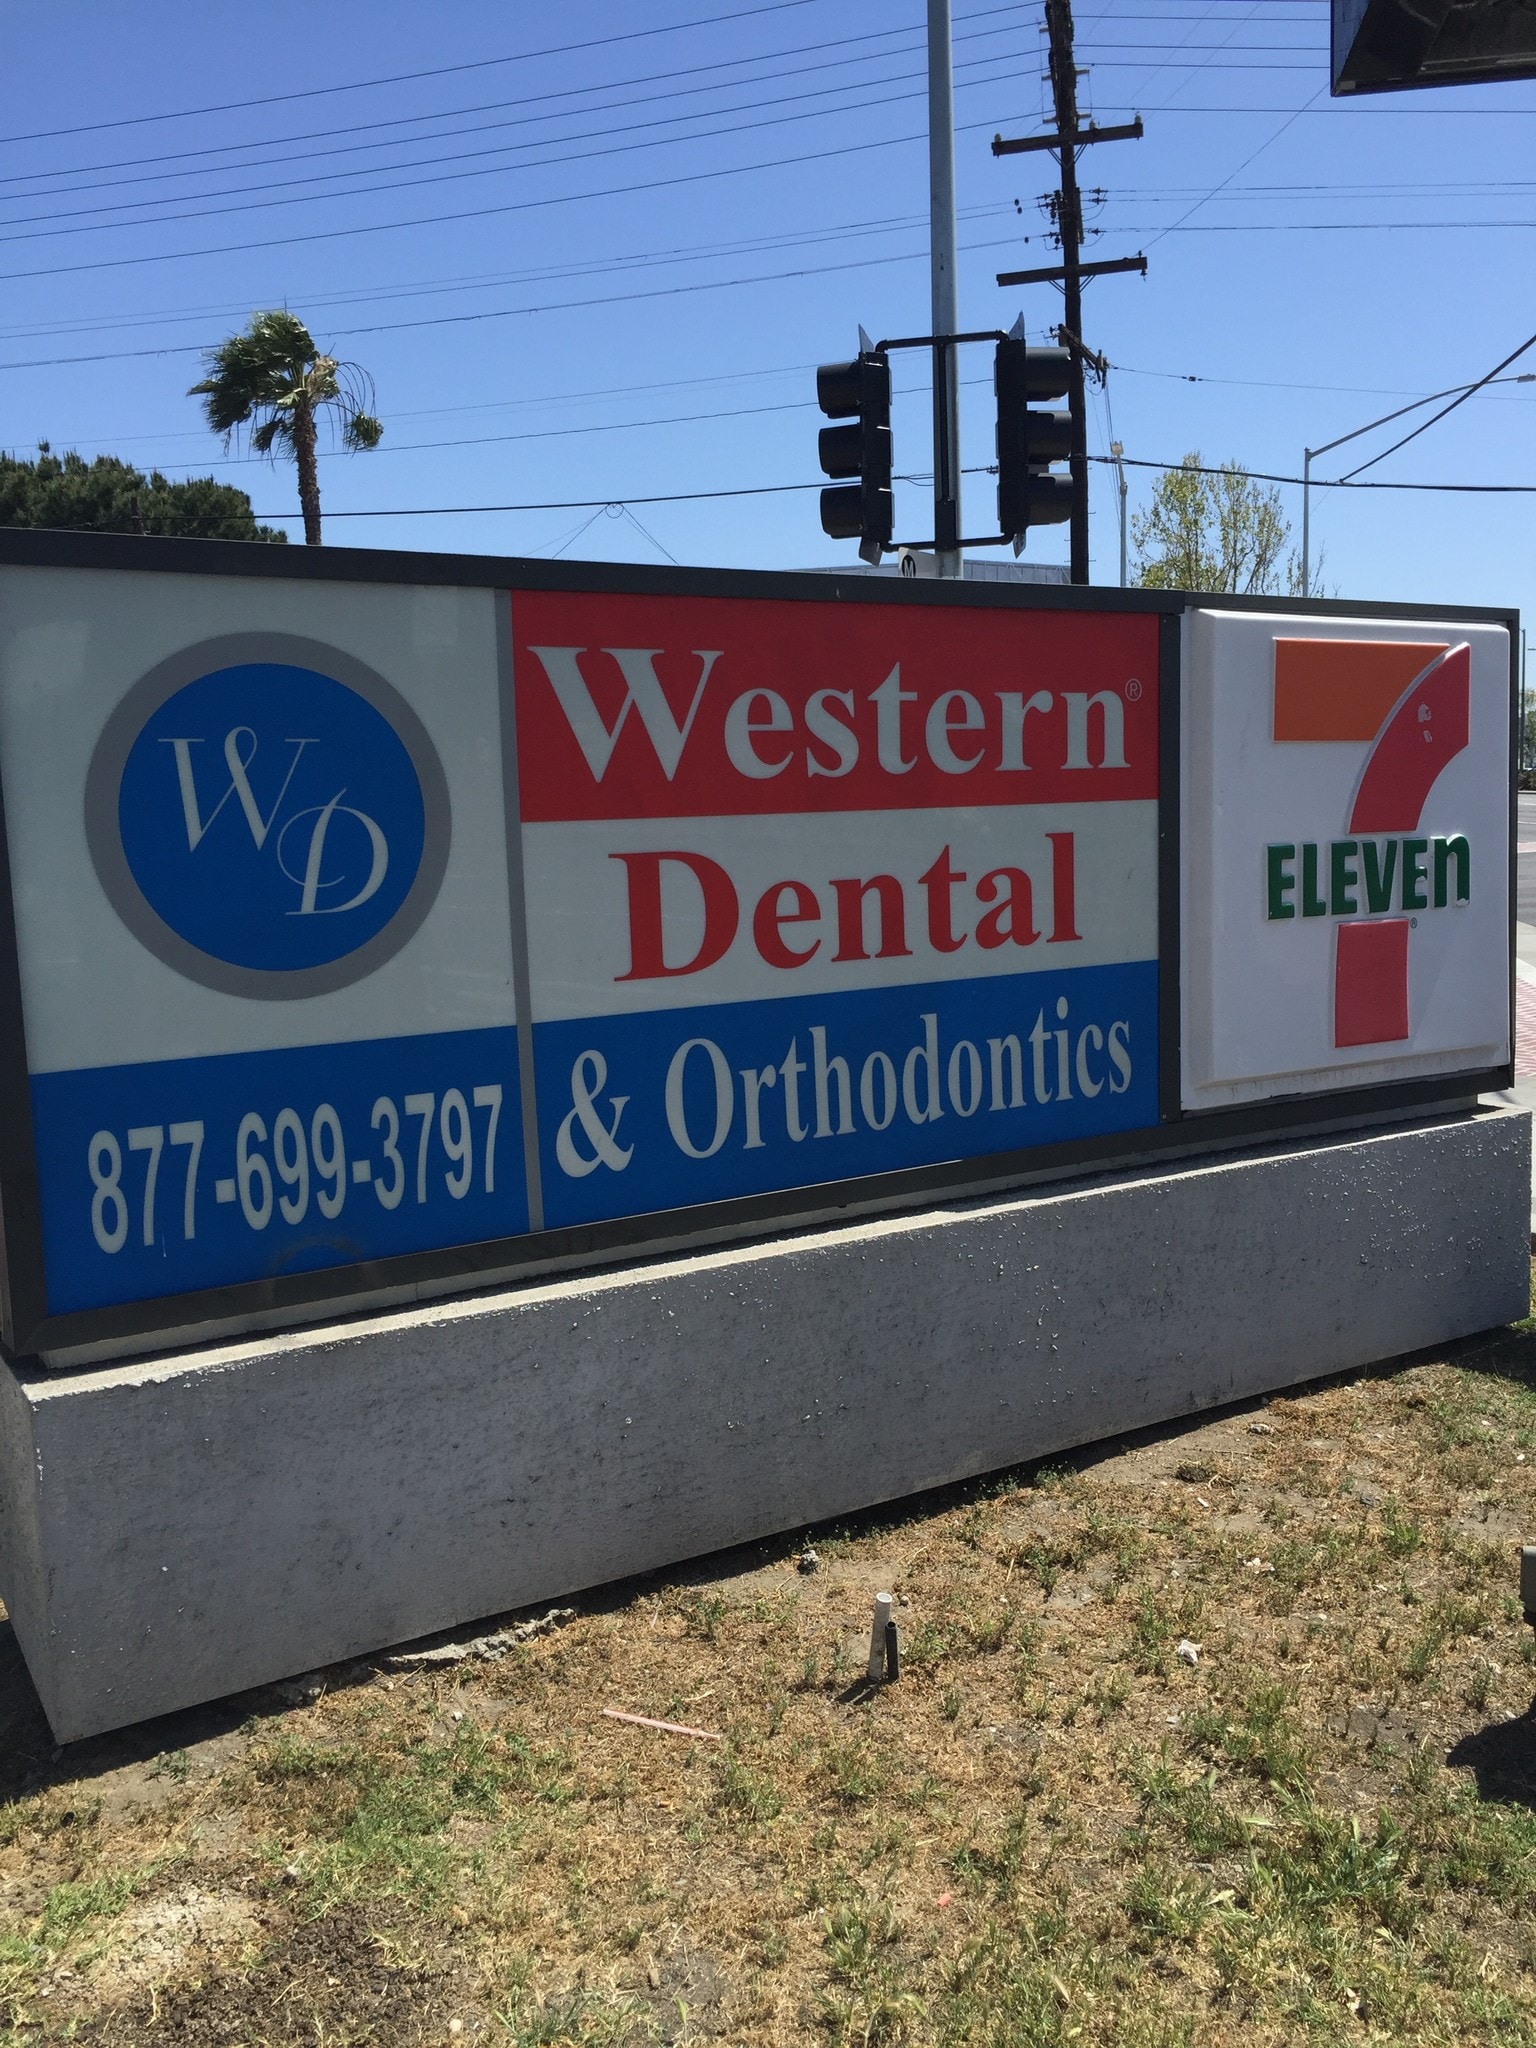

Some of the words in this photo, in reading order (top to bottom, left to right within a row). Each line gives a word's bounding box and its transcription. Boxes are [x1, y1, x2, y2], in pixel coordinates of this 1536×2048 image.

[527, 645, 1131, 783] Western
[608, 831, 1083, 982] Dental
[1273, 637, 1471, 1048] 7
[88, 1084, 503, 1254] 877-699-3797
[555, 1049, 635, 1178] &
[664, 995, 1133, 1158] Orthodontics
